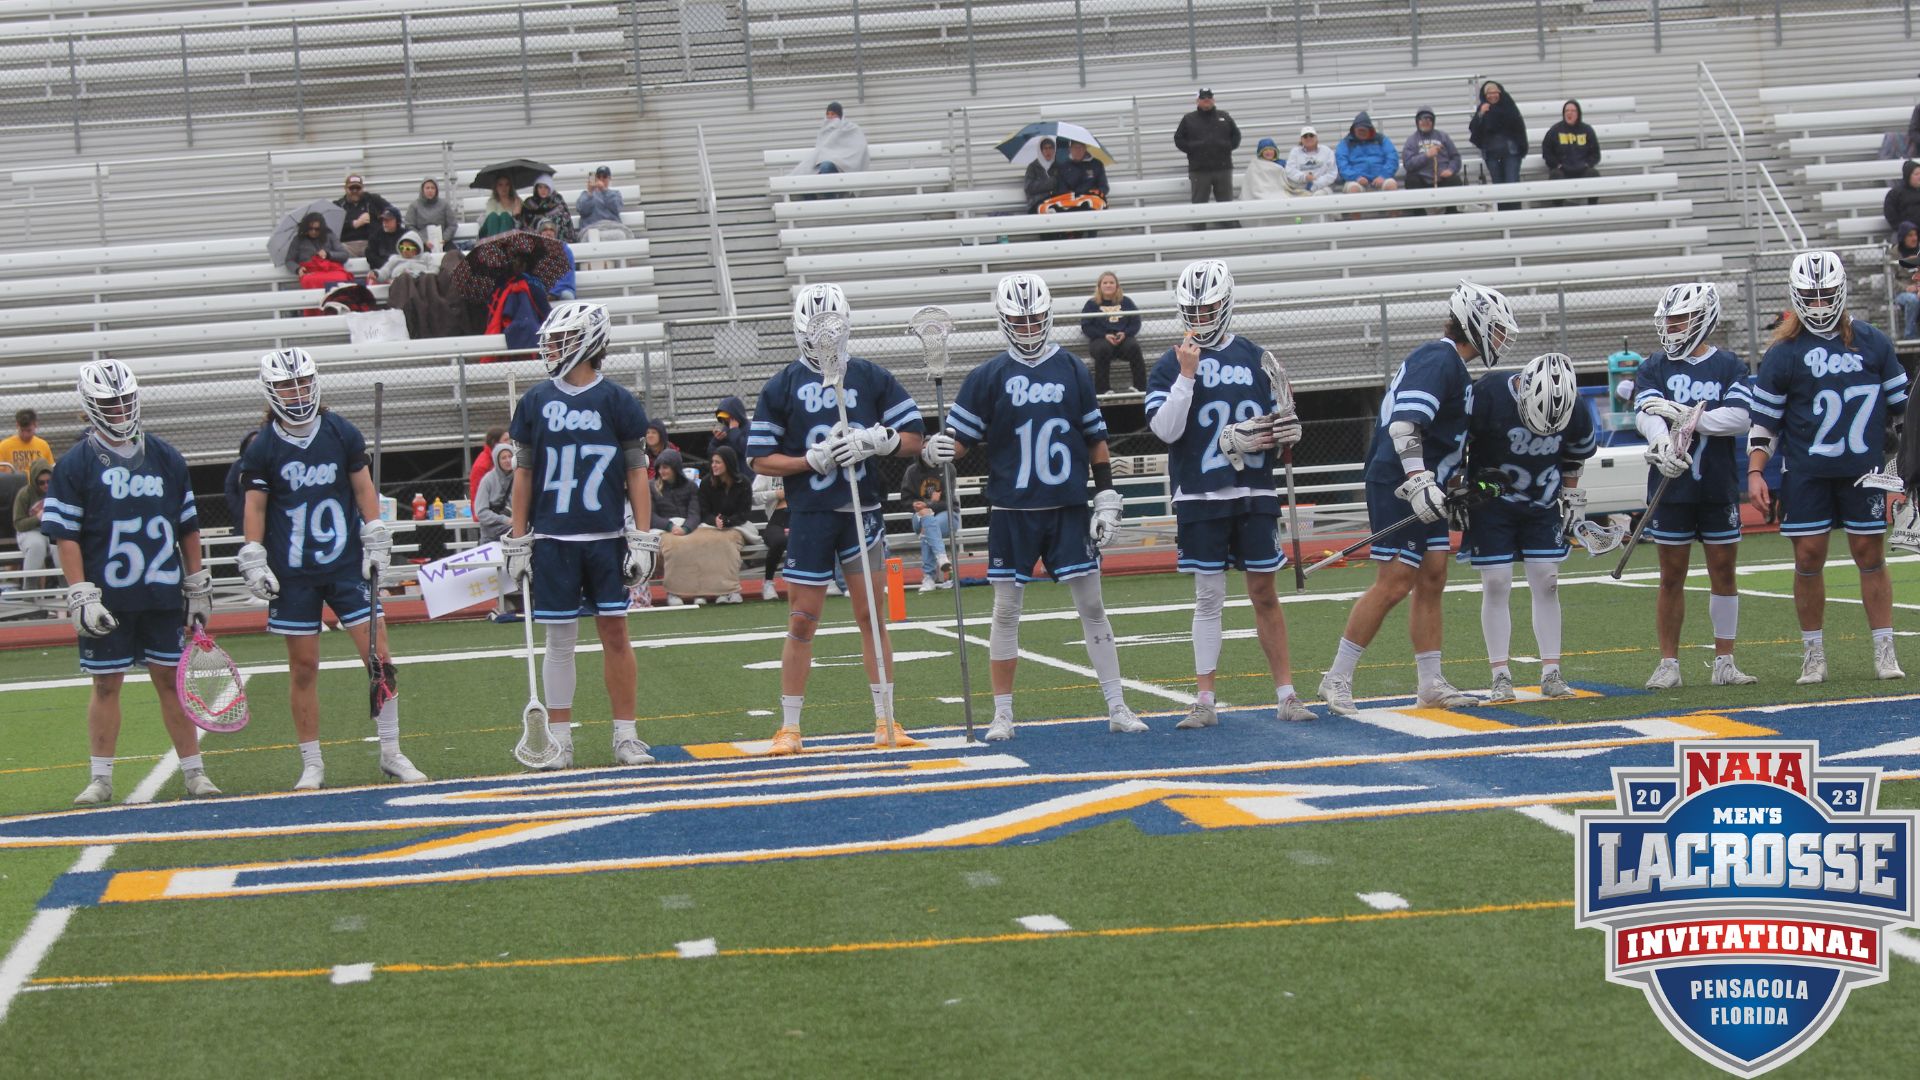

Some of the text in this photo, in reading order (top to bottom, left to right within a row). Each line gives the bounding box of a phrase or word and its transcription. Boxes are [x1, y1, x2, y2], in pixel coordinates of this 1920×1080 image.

[1196, 358, 1253, 388] Bees
[1804, 346, 1863, 378] Bees
[797, 381, 858, 413] Bes
[1005, 374, 1066, 407] Bees
[1667, 373, 1722, 404] Bees
[542, 400, 602, 432] Bees
[1808, 383, 1882, 457] 27
[1015, 417, 1072, 489] 16
[1507, 426, 1563, 456] Bees
[101, 466, 164, 500] Bees
[280, 460, 338, 492] Bees
[543, 443, 618, 514] 47
[285, 498, 348, 568] 19
[104, 514, 181, 588] 52
